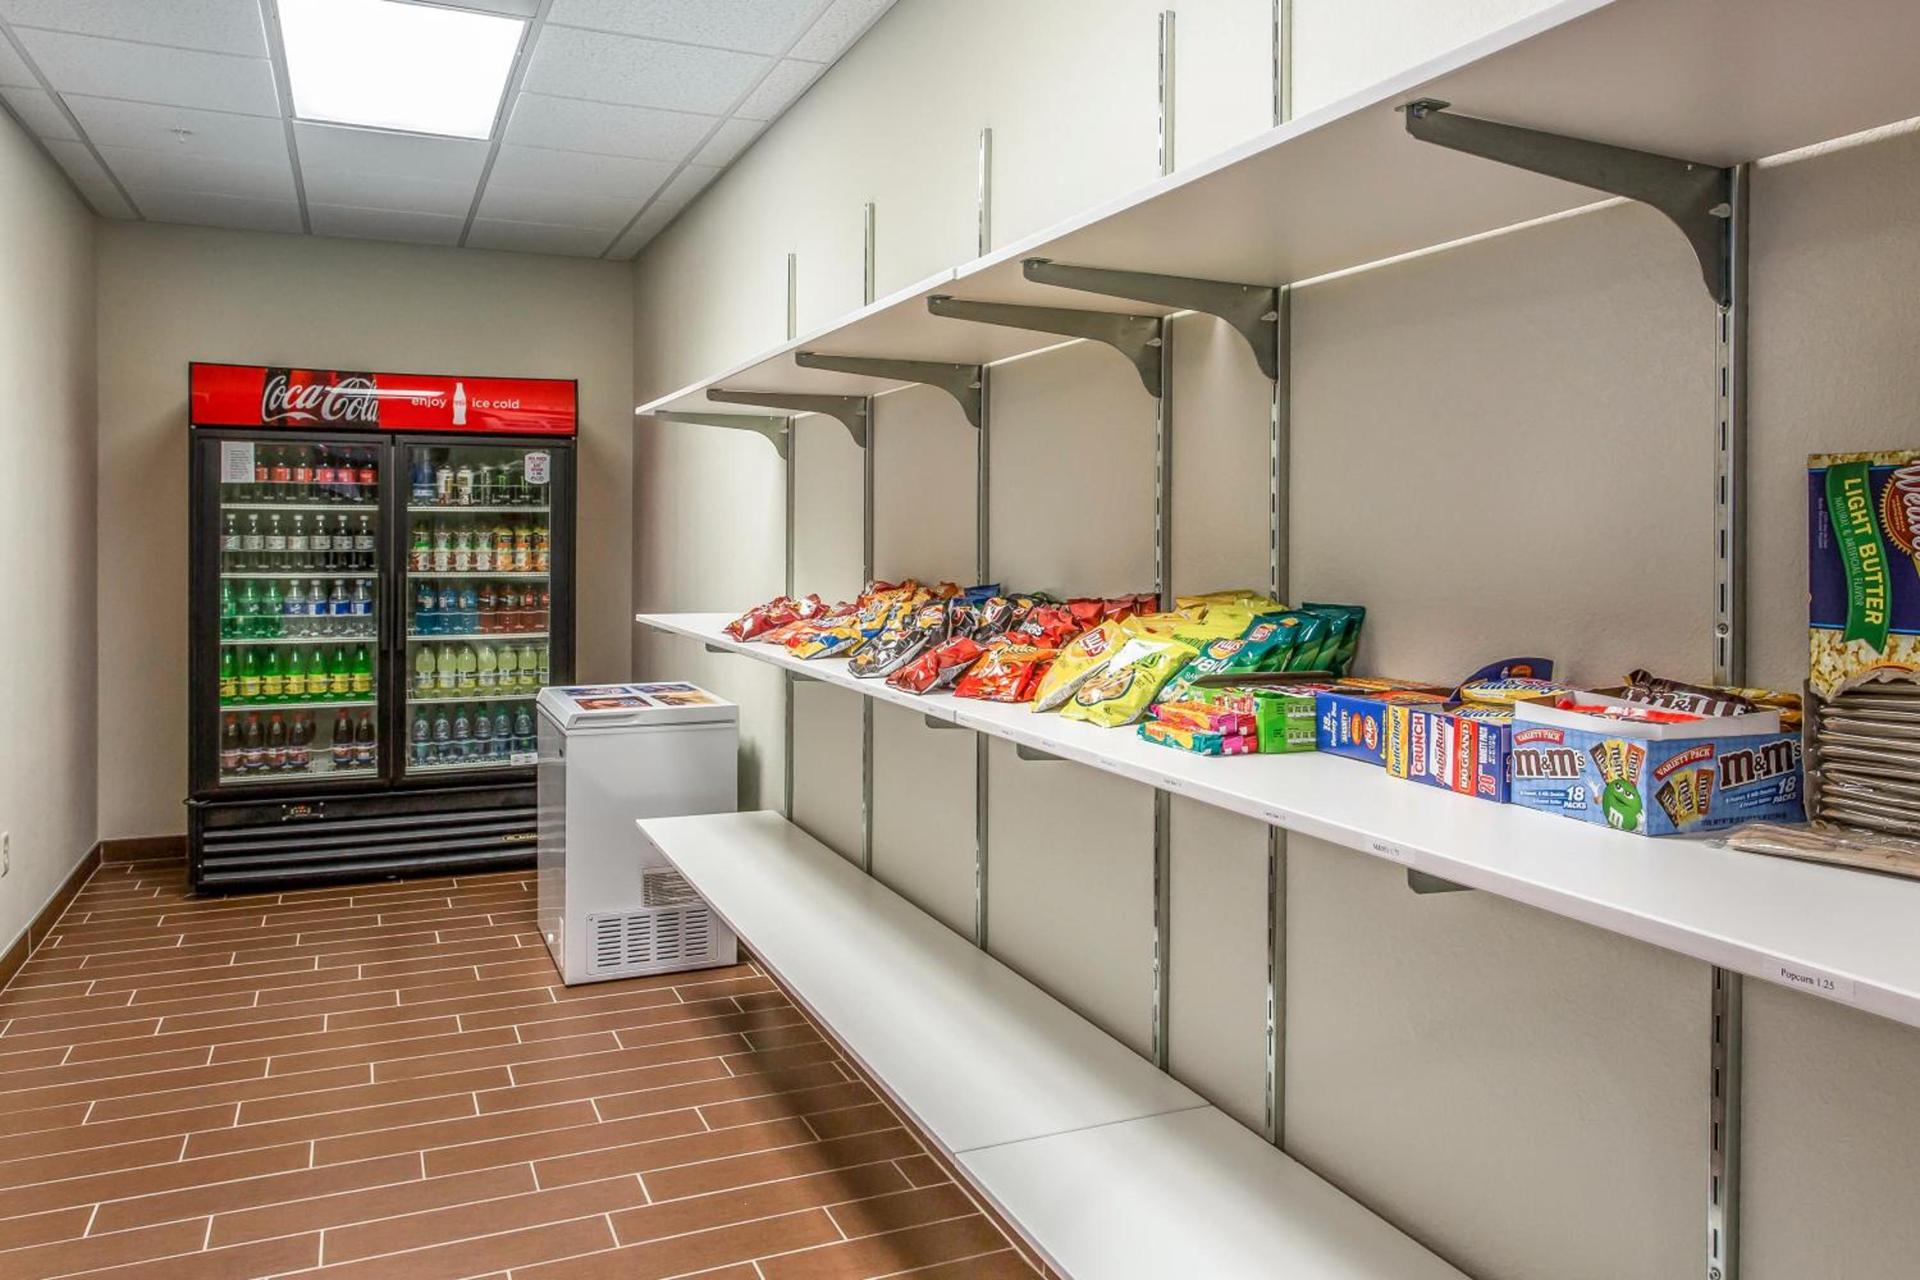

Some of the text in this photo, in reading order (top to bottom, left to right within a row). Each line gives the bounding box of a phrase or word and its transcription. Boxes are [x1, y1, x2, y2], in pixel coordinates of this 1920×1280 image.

[411, 396, 447, 409] enjoy
[472, 398, 520, 409] ice cold
[1844, 478, 1884, 624] LIGHT BUTTER
[1391, 705, 1401, 774] Butterfinger
[1413, 715, 1424, 774] CRUNCH
[1516, 730, 1560, 741] VARIETY PACK
[1461, 723, 1469, 768] GRAND
[1657, 748, 1711, 775] VARIETY PACK
[1478, 775, 1495, 795] 20
[1566, 786, 1585, 801] 18
[1778, 776, 1797, 795] 18
[1563, 801, 1587, 810] PACKS
[1772, 792, 1797, 804] PACKS
[1780, 968, 1814, 985] Popcorn
